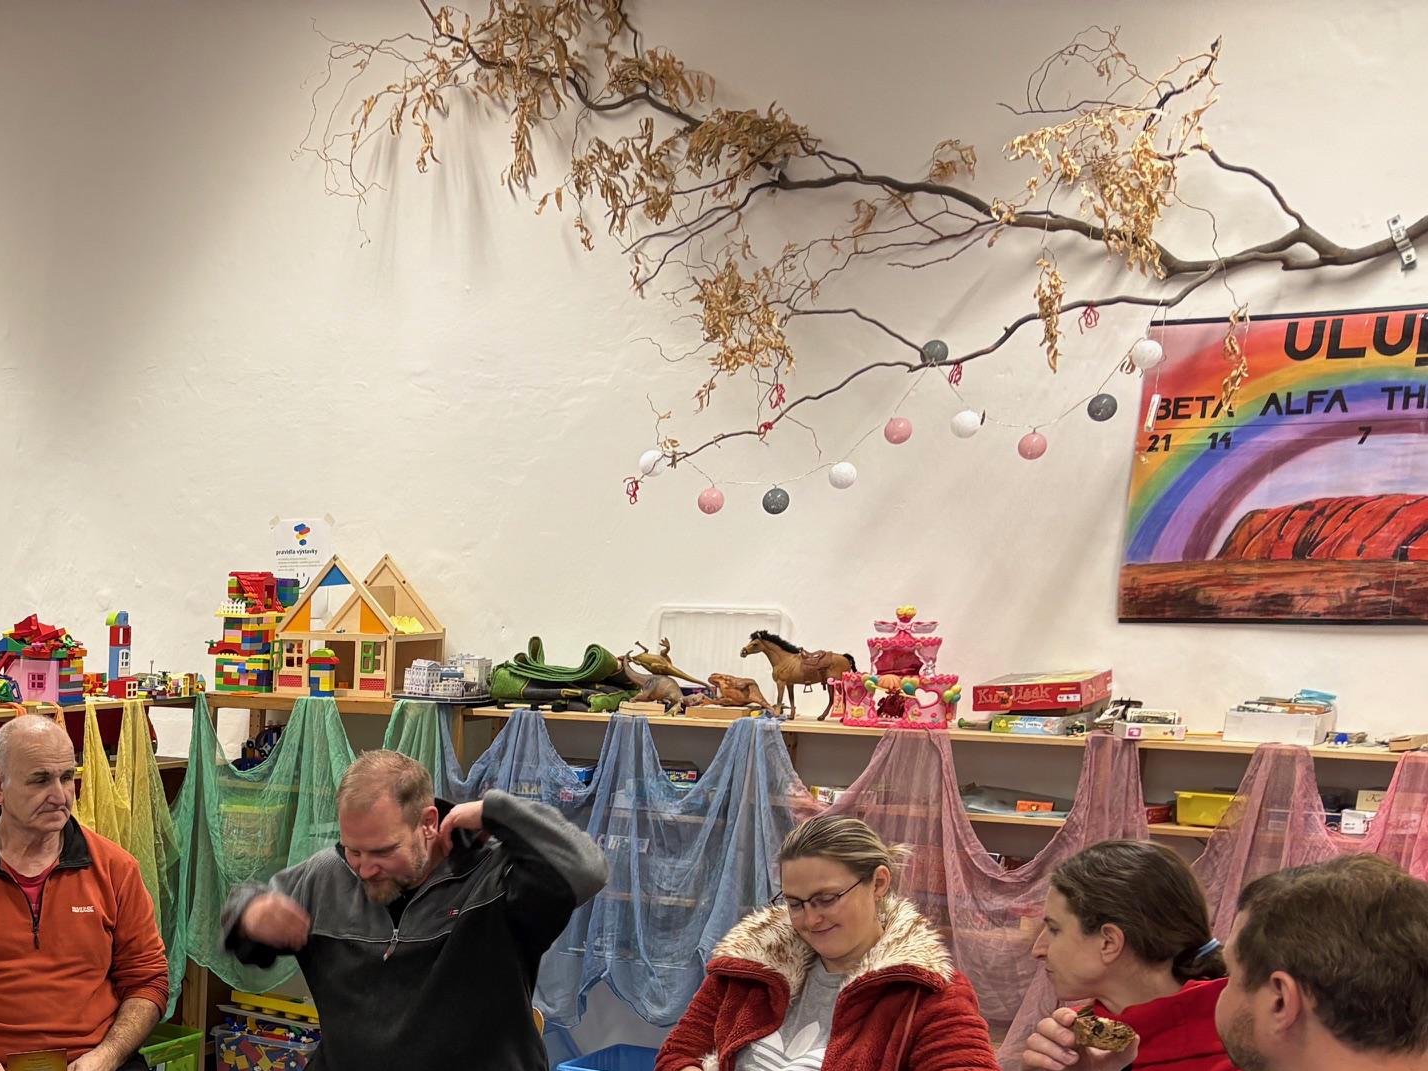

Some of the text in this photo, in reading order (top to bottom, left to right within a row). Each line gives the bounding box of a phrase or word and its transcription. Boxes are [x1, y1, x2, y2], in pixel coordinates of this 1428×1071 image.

[1156, 384, 1428, 420] BETA ALFA TH
[1147, 426, 1372, 452] 21 14 7
